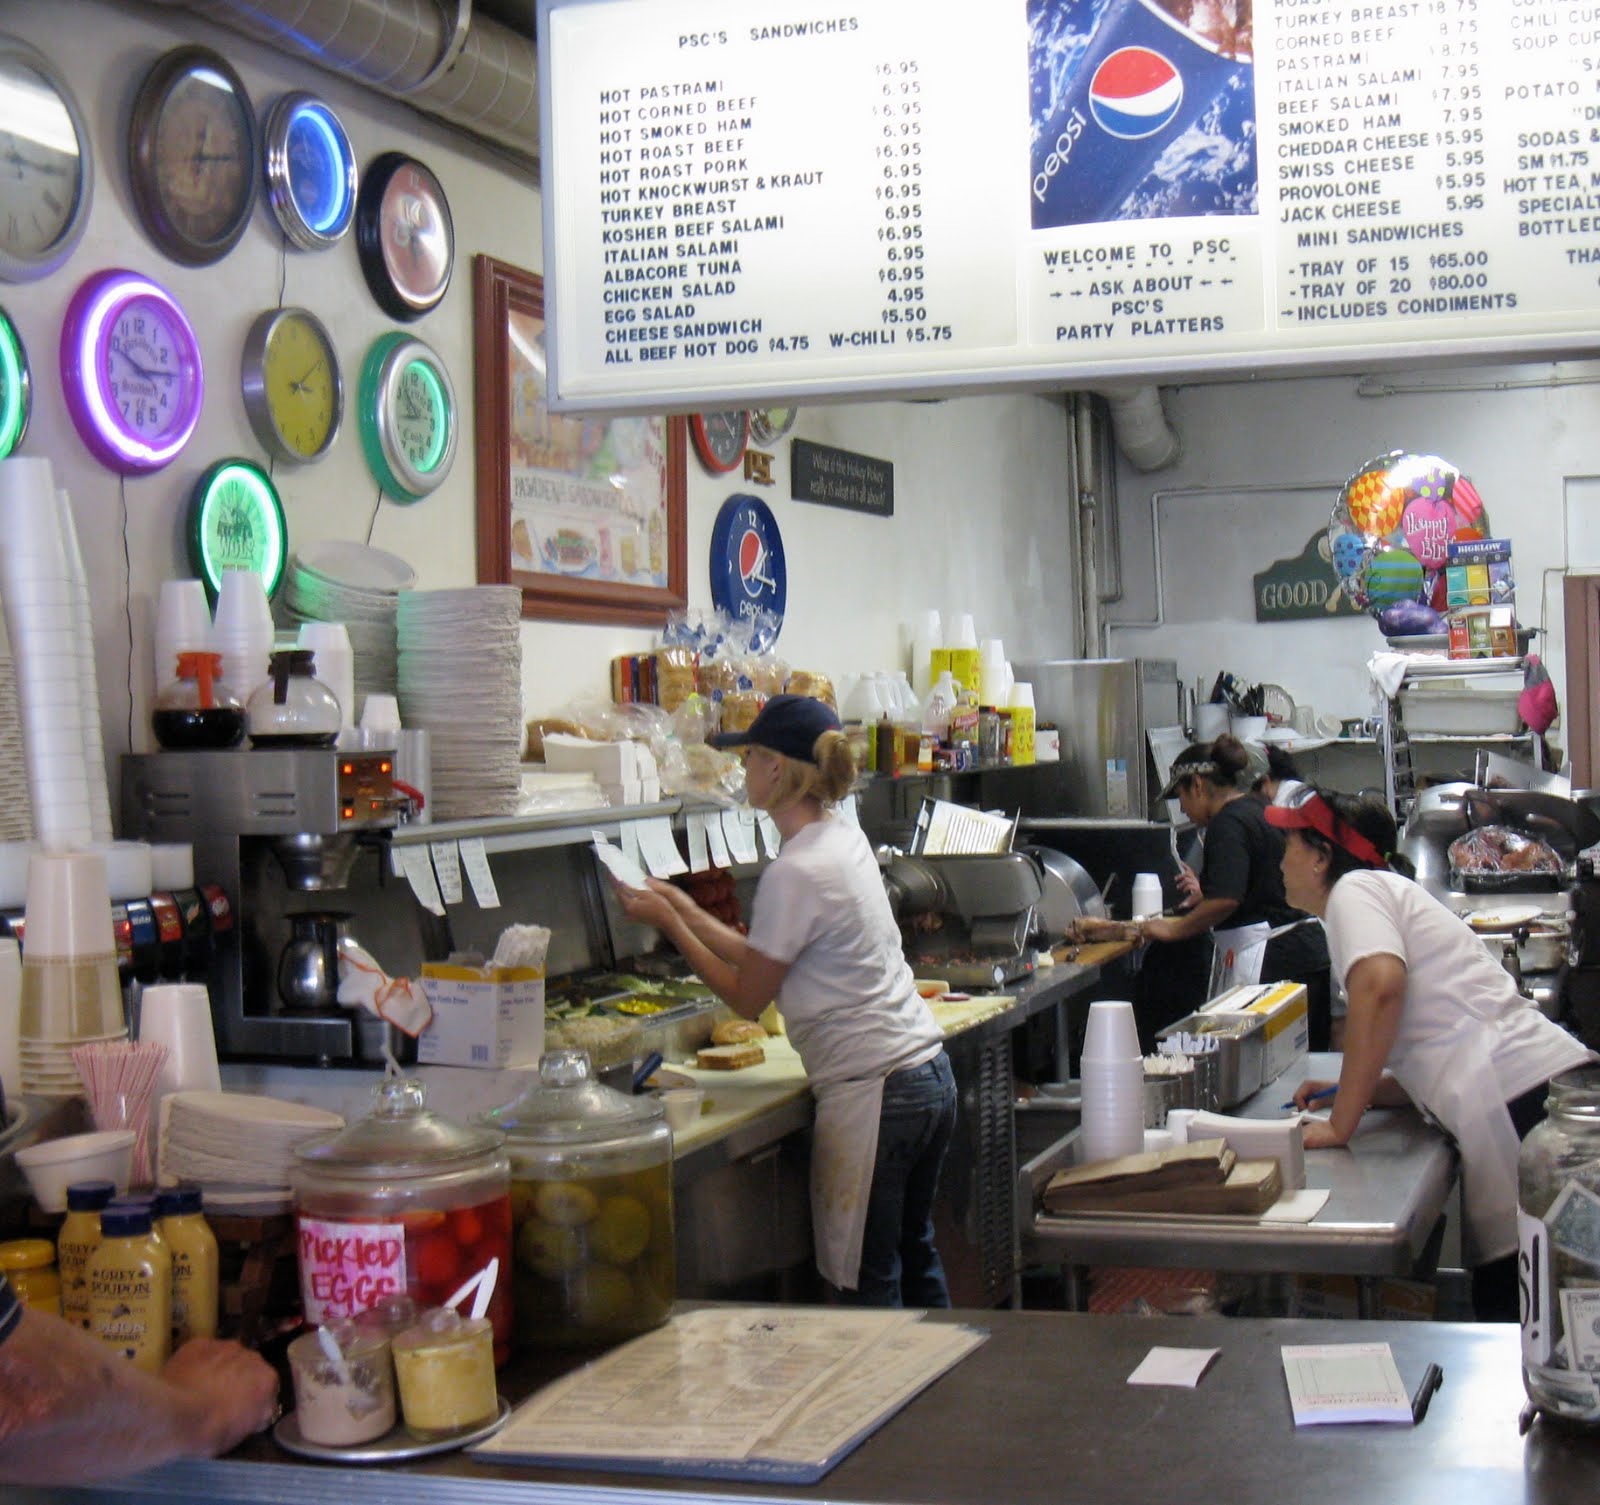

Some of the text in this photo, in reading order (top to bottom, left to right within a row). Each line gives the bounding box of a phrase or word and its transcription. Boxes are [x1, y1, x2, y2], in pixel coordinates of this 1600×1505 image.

[1275, 11, 1342, 29] TURKEY
[1351, 3, 1420, 22] BREAST
[1511, 8, 1600, 29] CHILI CUP
[679, 17, 859, 48] PSC'S SANDWICHES
[1275, 32, 1344, 50] CORNED
[1351, 27, 1395, 44] BEEF
[1512, 30, 1600, 51] SOUP CUP
[875, 61, 919, 76] $6.95
[1277, 52, 1369, 72] PASTRAMI
[883, 81, 920, 96] 6.95
[1278, 63, 1479, 93] ITALIAN SALAMI 7.95
[600, 80, 723, 104] HOT PASTRAMI
[1278, 85, 1481, 114] BEEF SALAMI $7.95
[1505, 81, 1580, 100] POTATO
[600, 96, 758, 125] HOT CORNED BEEF
[1278, 106, 1483, 136] SMOKED HAM 7.95
[600, 116, 752, 145] HOT SMOKED HAM
[883, 122, 921, 137] 6.95
[1517, 129, 1580, 148] SODAS
[600, 138, 745, 165] HOT ROAST BEEF
[875, 142, 921, 158] $6.95
[1033, 106, 1087, 203] pepsi
[1278, 128, 1484, 158] CHEDDAR CHEESE $5.95
[600, 158, 748, 184] HOT ROAST PORK
[883, 163, 922, 179] 6.95
[1279, 150, 1485, 180] SWISS CHEESE 5.95
[1517, 150, 1589, 170] SM $1.75
[600, 171, 823, 204] HOT KNOCKWURST & KRAUT
[875, 183, 922, 200] $6.95
[1279, 172, 1486, 202] PROVOLONE $5.95
[1503, 177, 1537, 194] HOT
[1543, 174, 1587, 193] TEA,
[601, 199, 736, 224] TURKEY BREAST
[885, 204, 922, 220] 6.95
[1280, 194, 1484, 224] JACK CHEESE 5.95
[602, 216, 784, 244] KOSHER BEEF SALAMI
[878, 225, 923, 242] $6.95
[1297, 222, 1464, 248] MINI SANDWICHES
[604, 240, 739, 264] ITALIAN SALAMI
[887, 245, 924, 261] 6.95
[1043, 239, 1231, 266] WELCOME TO PSC
[1356, 258, 1377, 273] OF
[1390, 256, 1410, 272] 15
[1429, 251, 1489, 270] $65.00
[603, 260, 742, 284] ALBACORE TUNA
[879, 266, 924, 283] $6.95
[603, 281, 736, 304] CHICKEN SALAD
[887, 286, 924, 303] 4.95
[1089, 276, 1194, 296] ASK ABOUT
[1356, 280, 1377, 295] OF
[1389, 278, 1411, 294] 20
[1429, 273, 1488, 291] $80.00
[604, 304, 695, 324] EGG SALAD
[882, 307, 927, 324] $5.50
[1111, 299, 1164, 316] PSC'S
[1298, 292, 1518, 321] INCLUDES CONDIMENTS
[134, 317, 145, 335] 12
[605, 319, 762, 343] CHEESE SANDWICH
[1056, 316, 1224, 341] PARTY PLATTERS
[160, 347, 168, 364] 2
[605, 325, 952, 364] ALL BEEF HOT DOG $4.75 W-CHILI $5.75
[748, 509, 757, 528] 12
[1406, 512, 1449, 540] Happy
[1457, 543, 1502, 554] BIGELOW
[1261, 578, 1328, 609] GOOD
[100, 1269, 135, 1280] GREY
